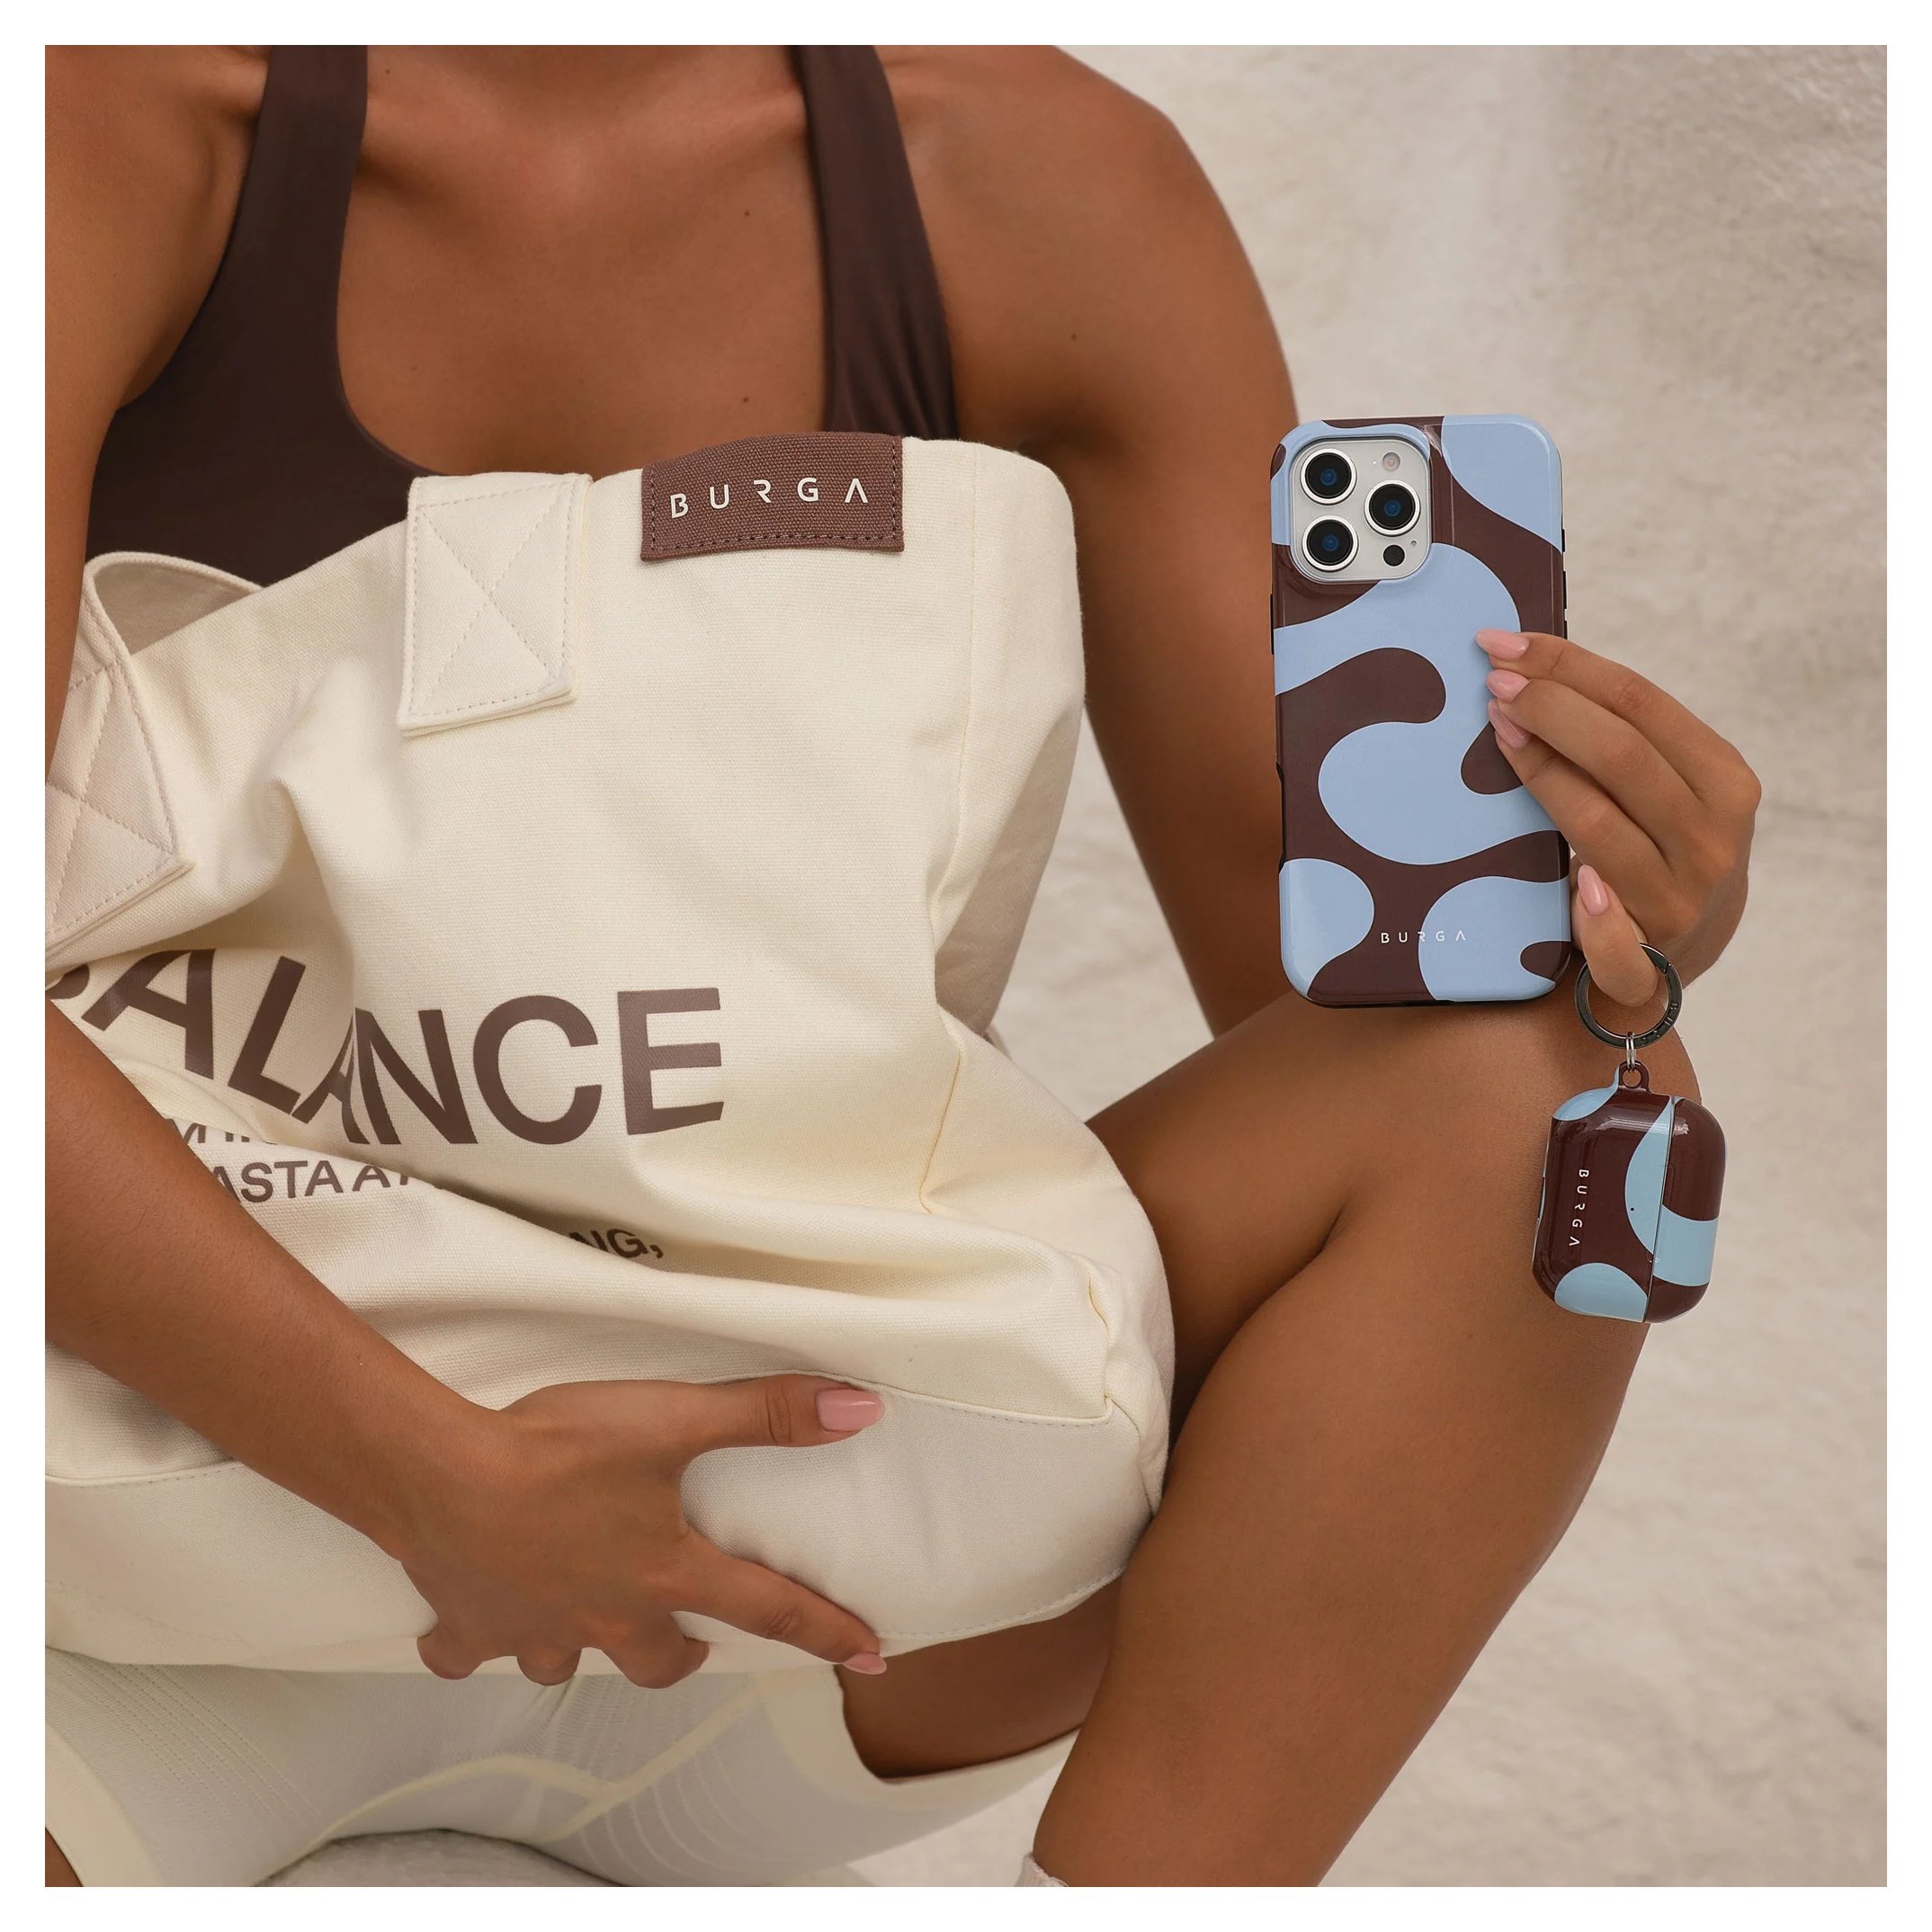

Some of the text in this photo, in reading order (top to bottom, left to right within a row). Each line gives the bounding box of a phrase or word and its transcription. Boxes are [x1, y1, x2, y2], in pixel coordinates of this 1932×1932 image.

[670, 477, 869, 519] BURGA
[1381, 929, 1467, 944] BURGA
[1569, 1168, 1590, 1248] BURGA
